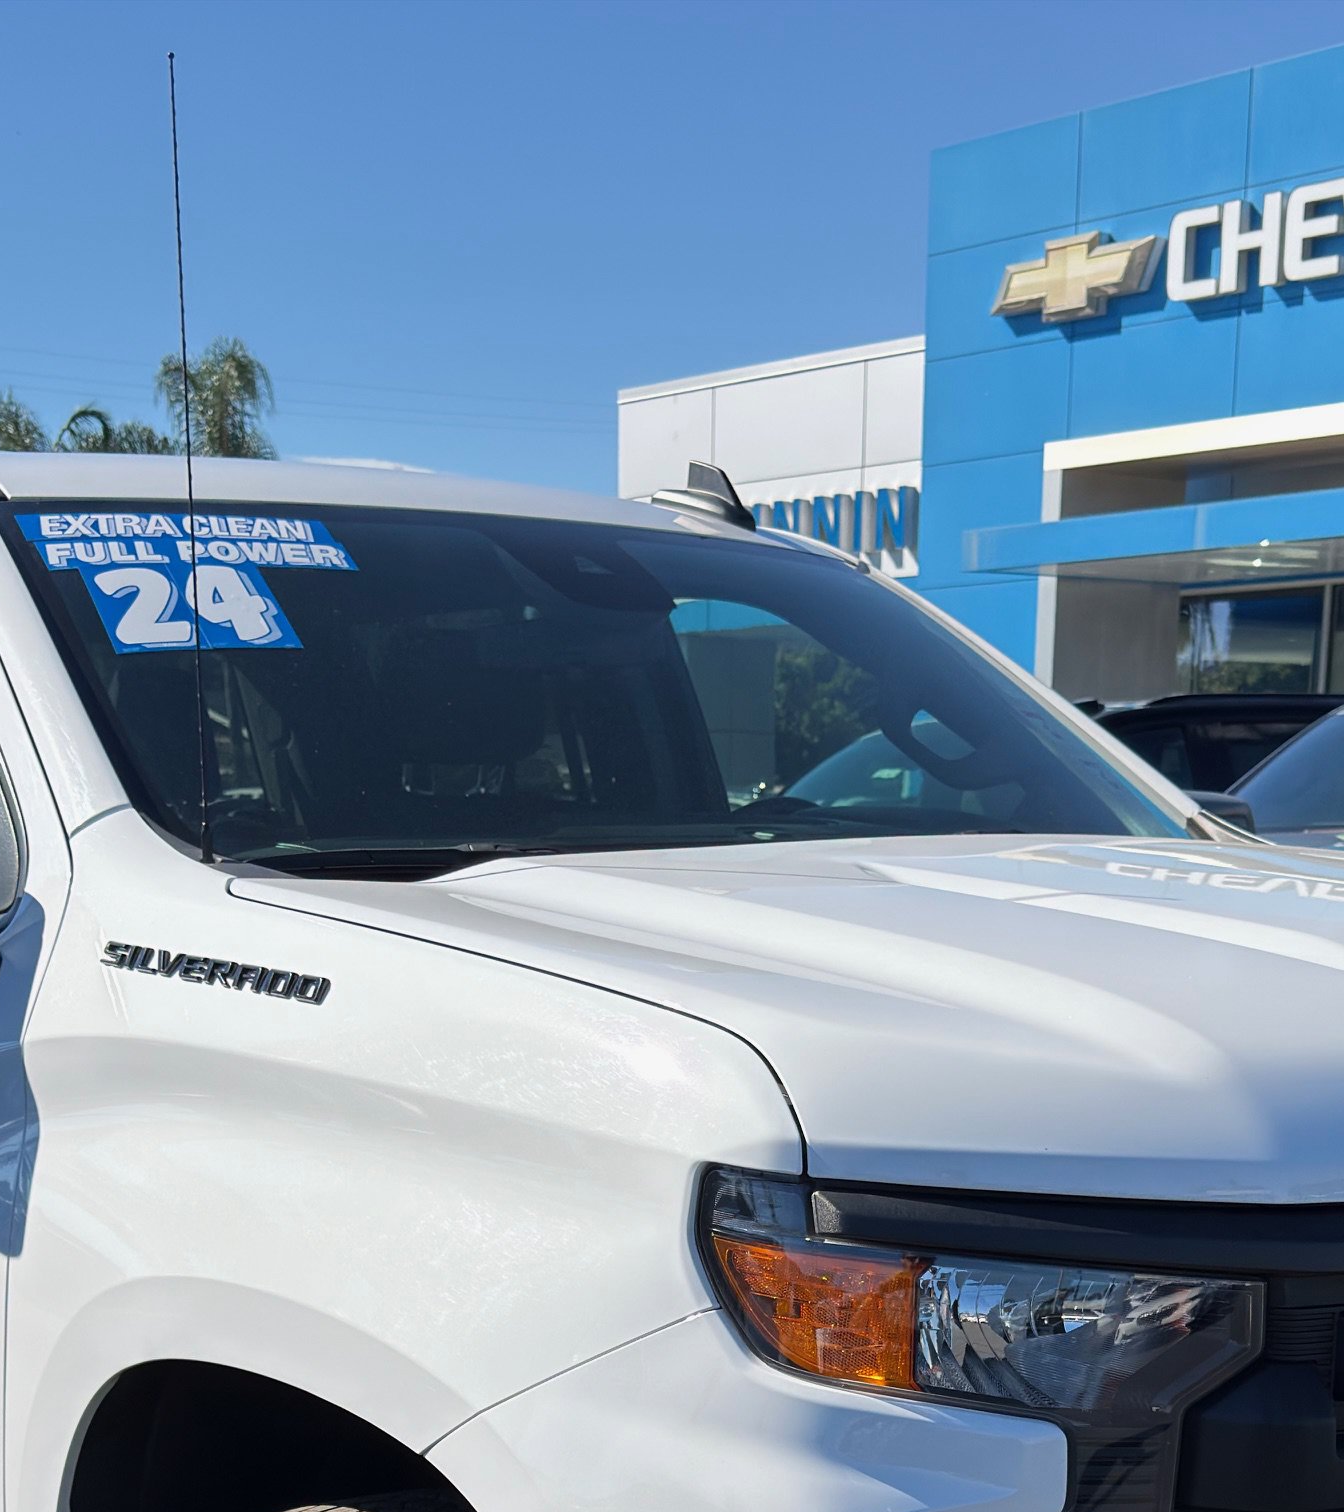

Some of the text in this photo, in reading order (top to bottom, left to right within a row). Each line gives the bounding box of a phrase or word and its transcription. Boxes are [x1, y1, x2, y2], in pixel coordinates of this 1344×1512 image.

[39, 514, 314, 542] EXTRA CLEAN
[45, 540, 349, 568] FULL POWER
[93, 564, 282, 646] 24
[99, 940, 332, 1006] SILVERADO
